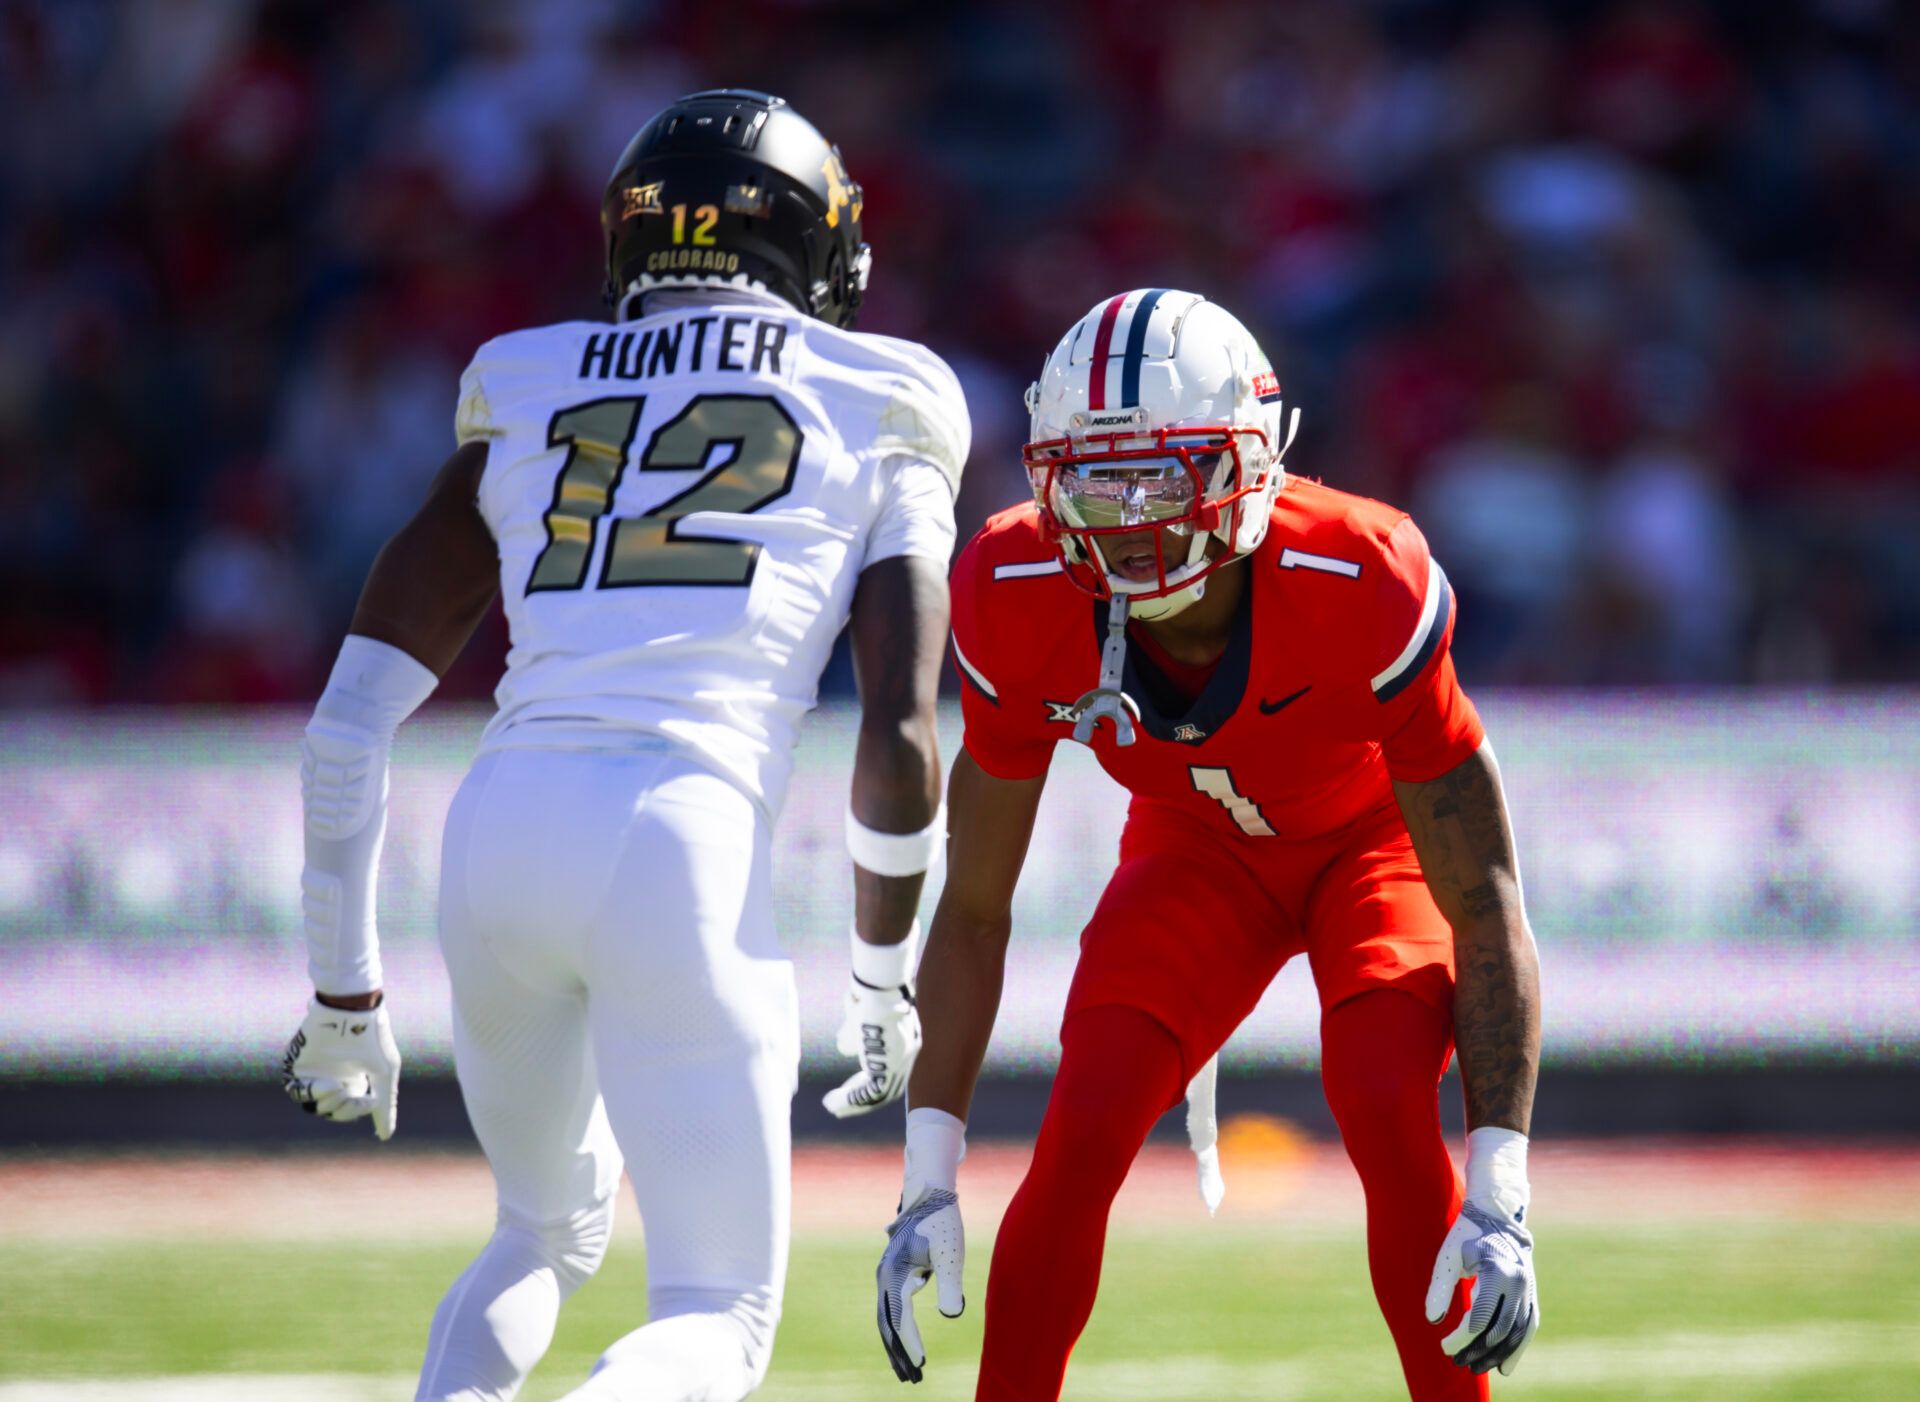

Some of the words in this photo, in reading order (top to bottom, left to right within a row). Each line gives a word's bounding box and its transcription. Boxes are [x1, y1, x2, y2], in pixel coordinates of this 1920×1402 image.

[671, 203, 719, 245] 12
[647, 249, 739, 272] COLORADO
[579, 316, 788, 380] HUNTER
[1091, 415, 1133, 426] ARIZONA
[524, 394, 804, 597] 12
[1279, 547, 1363, 579] 1
[1188, 765, 1279, 836] 1
